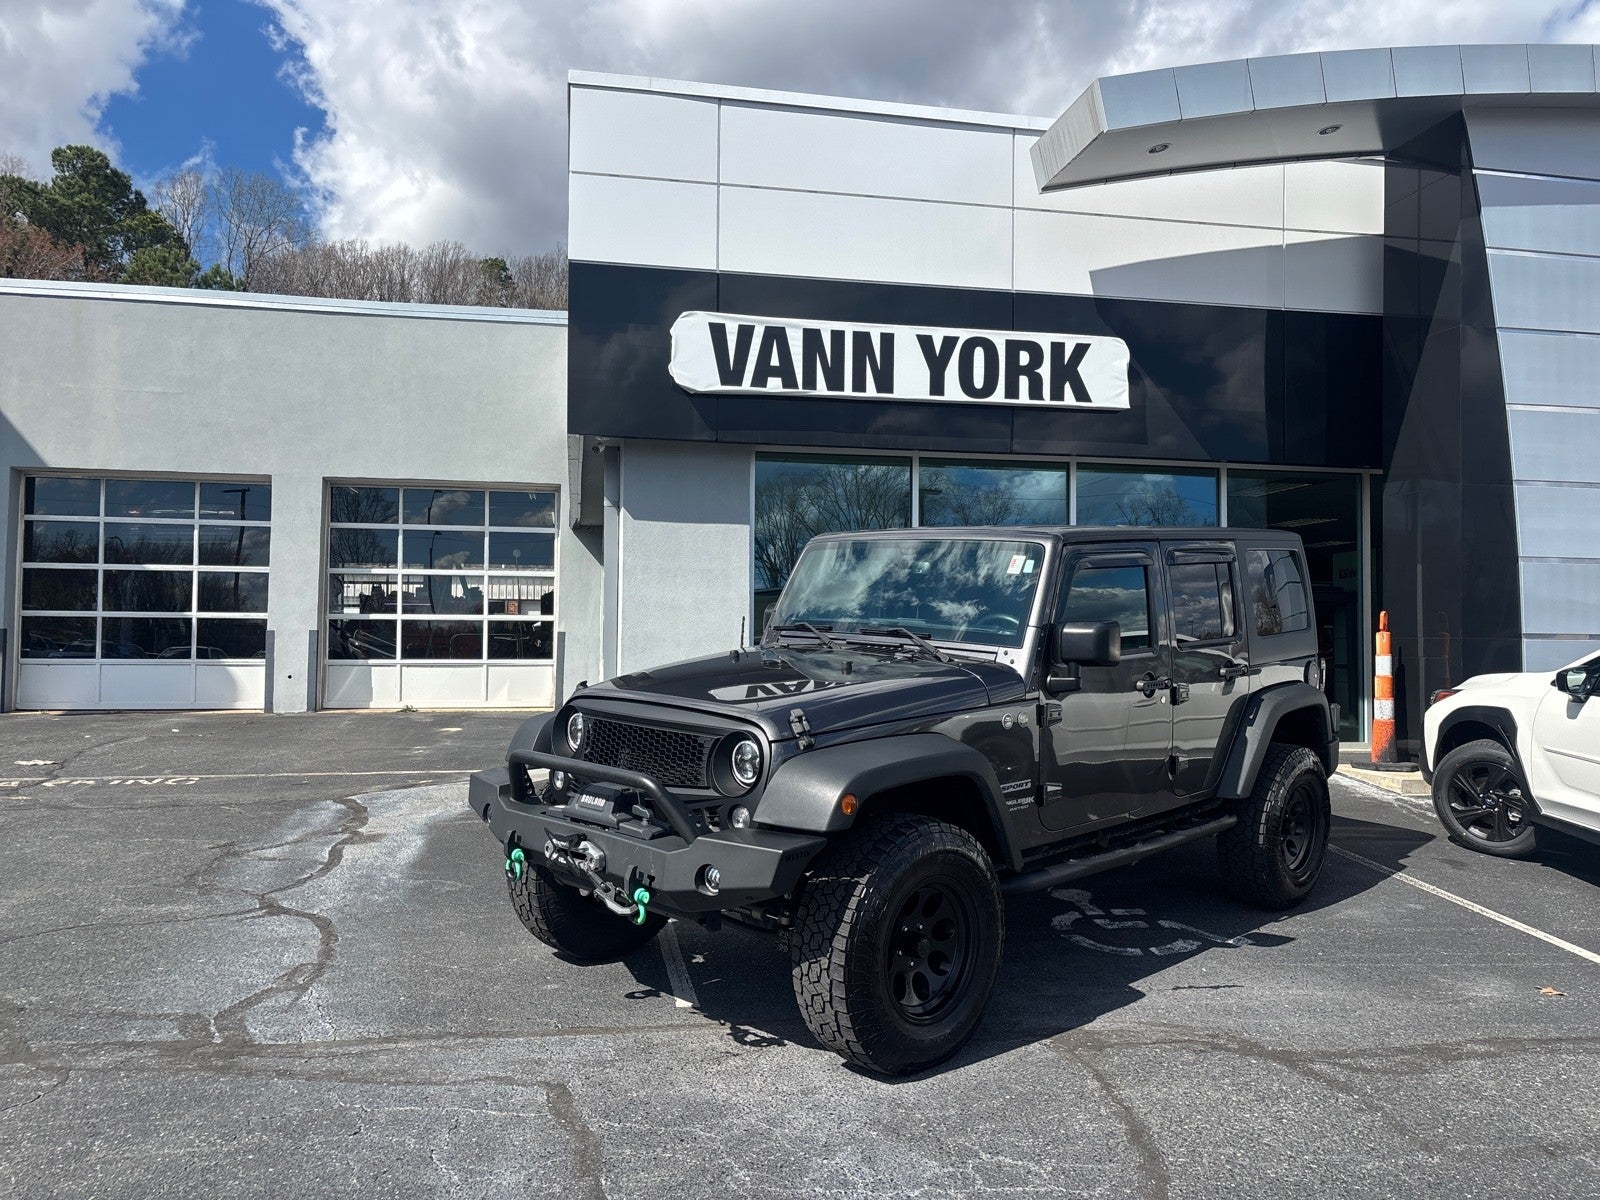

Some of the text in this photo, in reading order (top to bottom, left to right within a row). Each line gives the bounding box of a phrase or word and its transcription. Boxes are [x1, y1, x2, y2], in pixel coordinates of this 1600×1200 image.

[708, 321, 1093, 403] VANN YORK
[1001, 781, 1029, 791] SPORT
